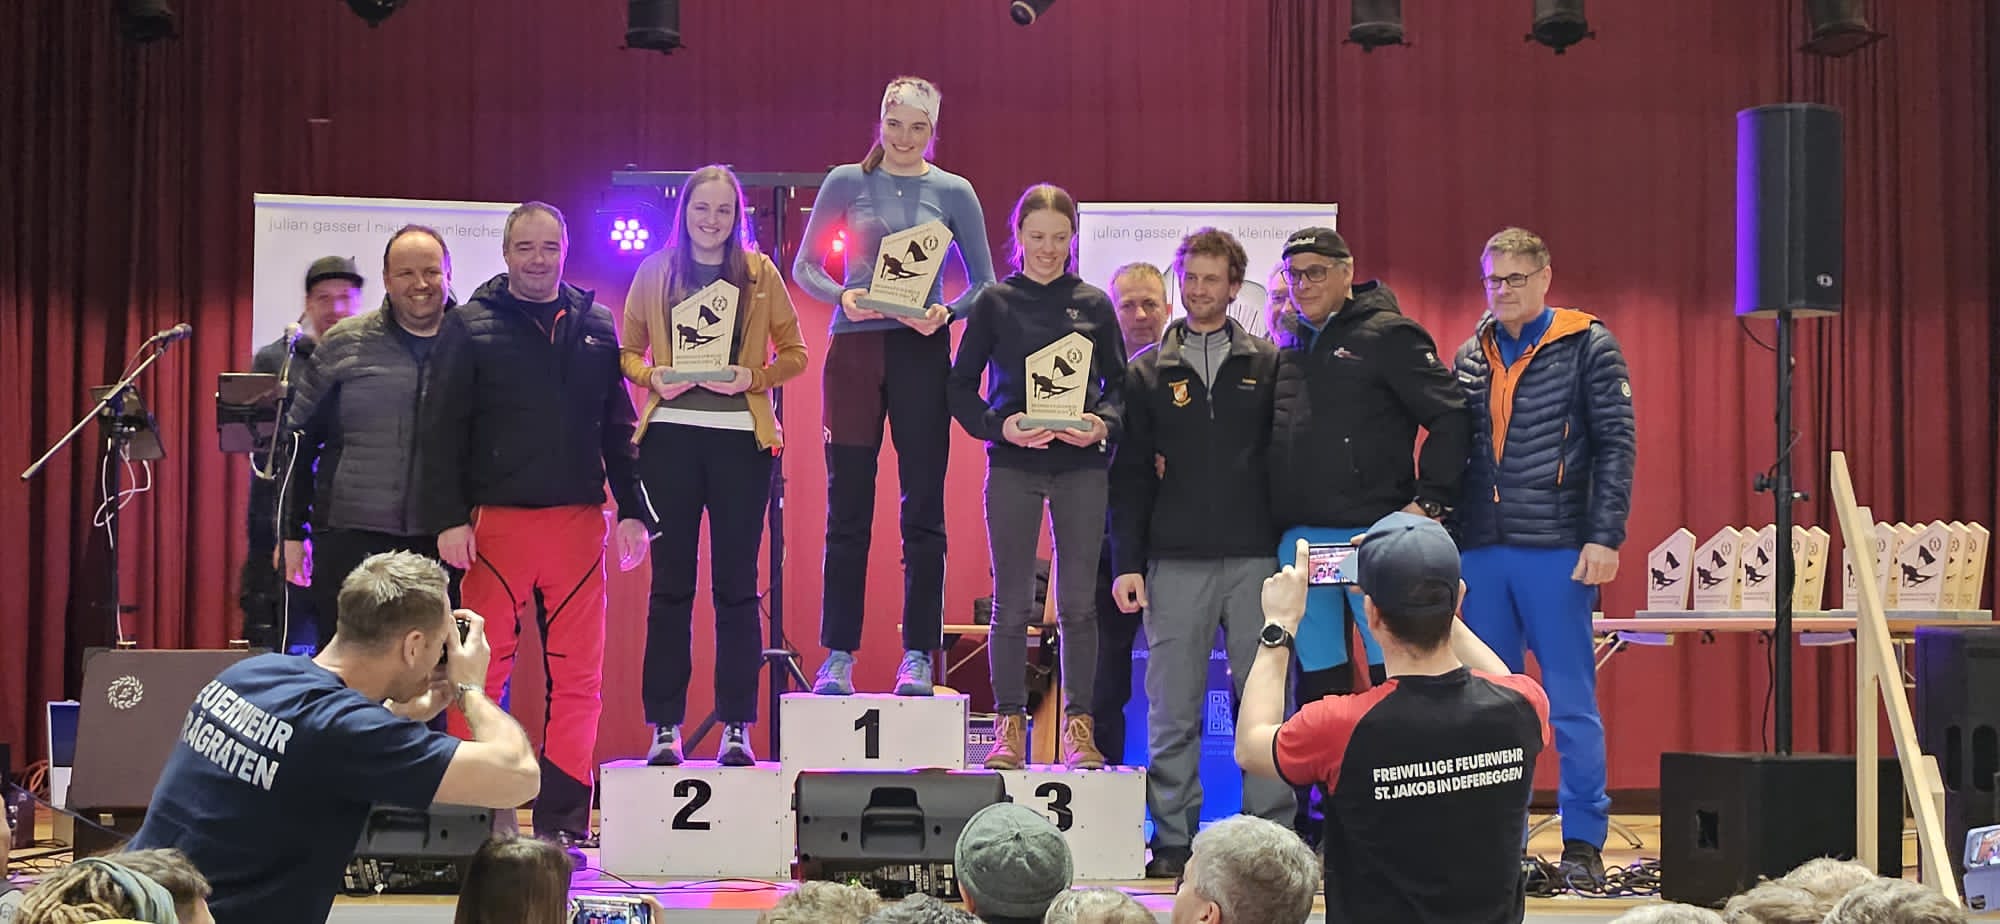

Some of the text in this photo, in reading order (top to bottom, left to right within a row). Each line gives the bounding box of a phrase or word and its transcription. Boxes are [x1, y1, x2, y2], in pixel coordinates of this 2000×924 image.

[268, 216, 308, 233] julian
[313, 220, 361, 234] gasser
[1092, 225, 1130, 241] julian
[1134, 228, 1181, 241] gasser
[183, 709, 280, 792] RÄGRATEN
[854, 709, 880, 759] 1
[1373, 748, 1524, 782] FREIWILLIGE FEUERWEHR
[1392, 781, 1436, 799] JAKOB
[1437, 779, 1451, 793] IN
[1452, 766, 1523, 791] DEFEREGGEN
[672, 779, 712, 830] 2
[1035, 782, 1073, 832] 3
